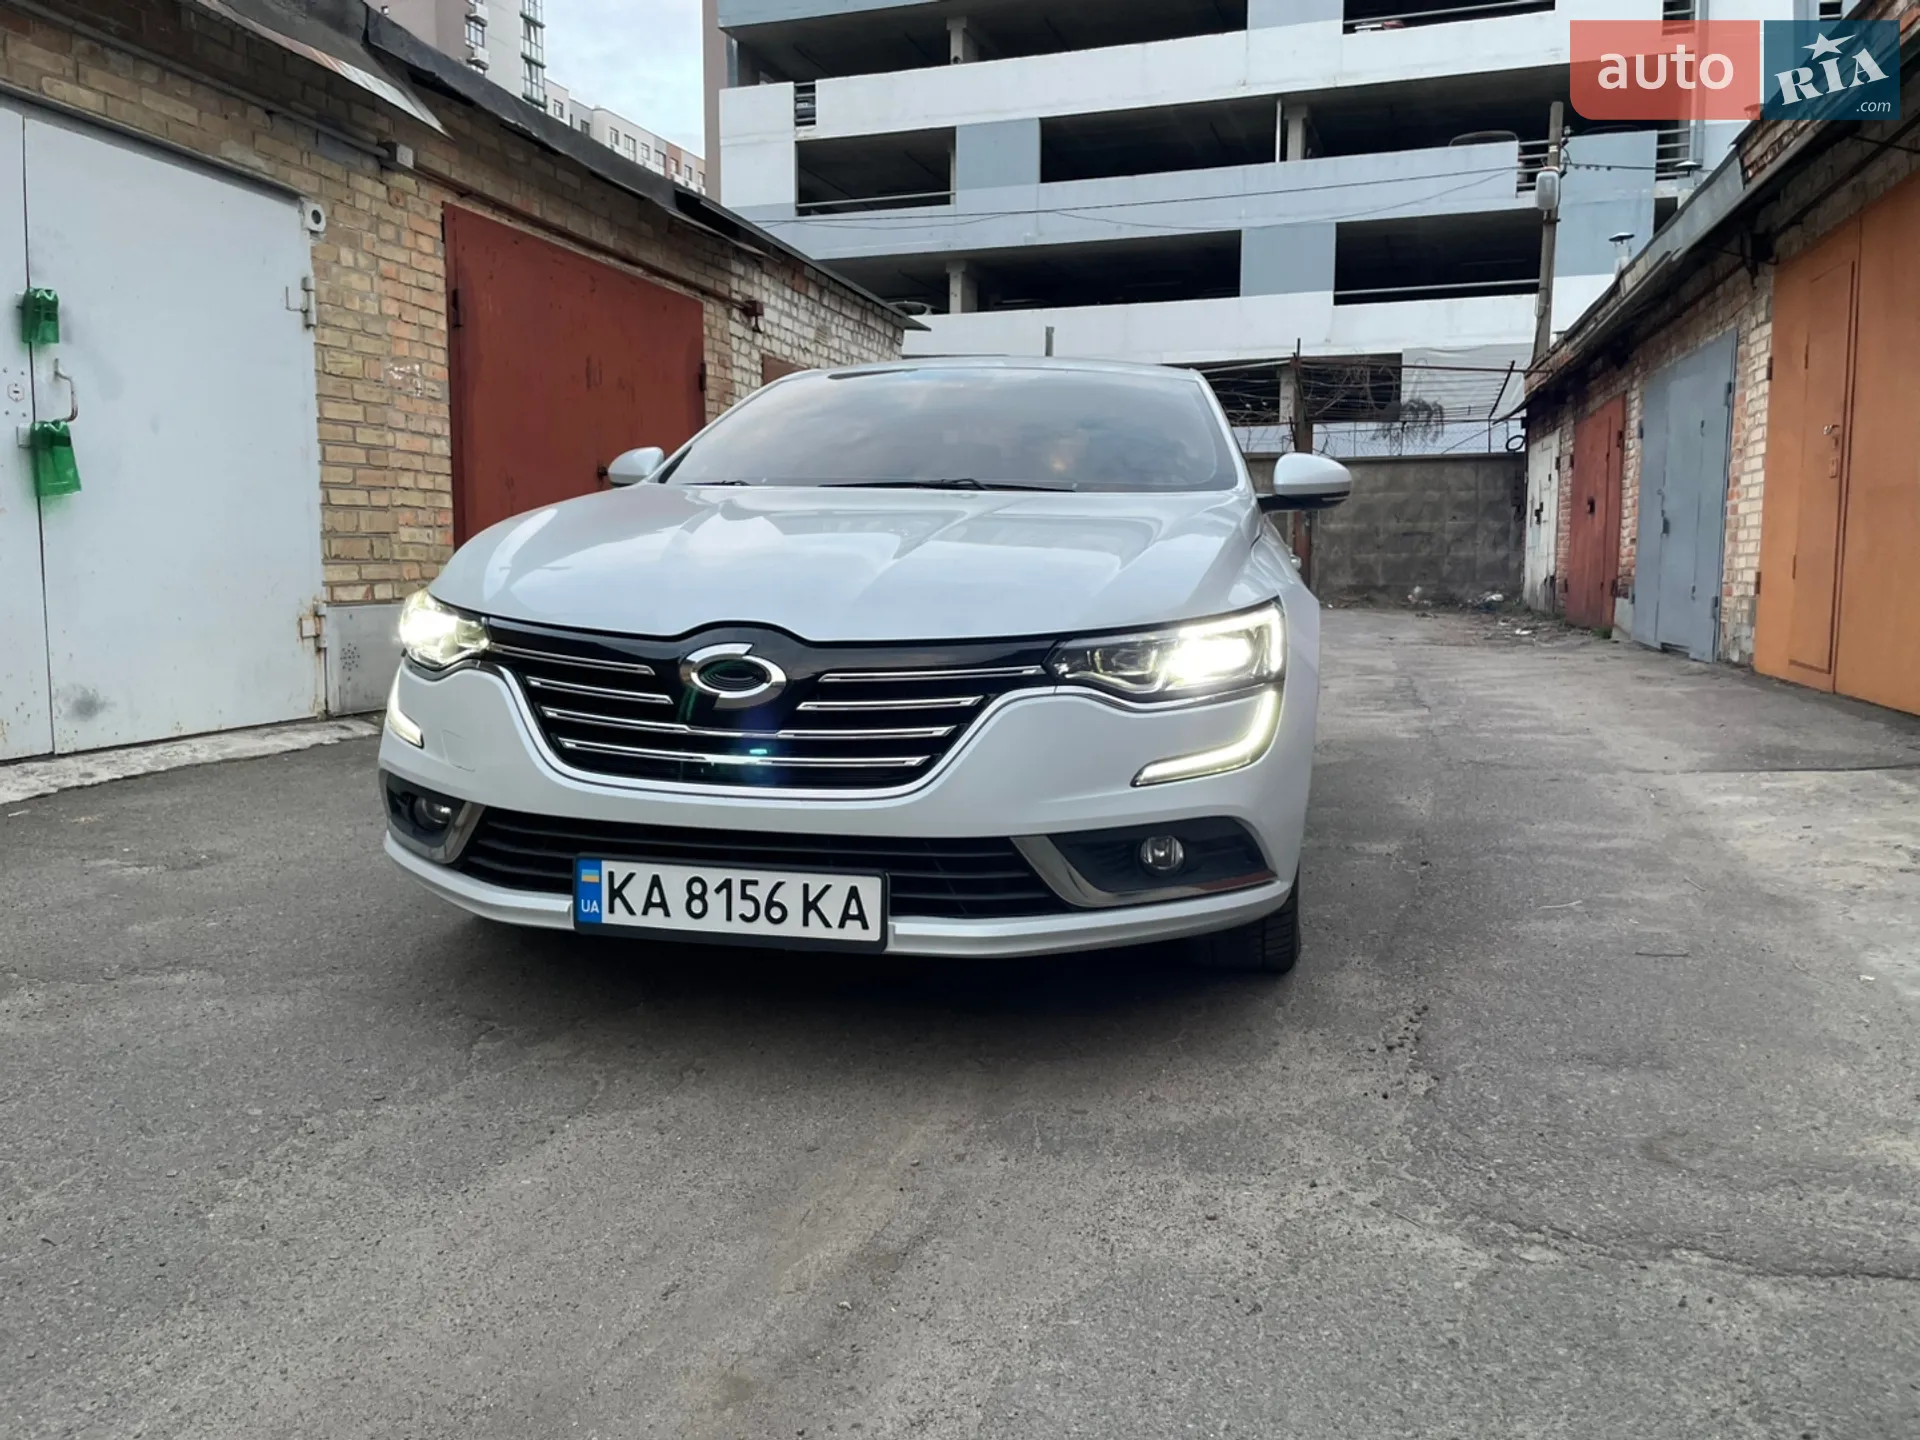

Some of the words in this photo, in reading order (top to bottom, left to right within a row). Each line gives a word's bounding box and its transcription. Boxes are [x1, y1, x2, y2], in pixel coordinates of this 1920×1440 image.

[581, 899, 600, 914] UA
[607, 871, 671, 918] KA
[685, 876, 788, 926] 8156
[802, 883, 870, 931] KA
